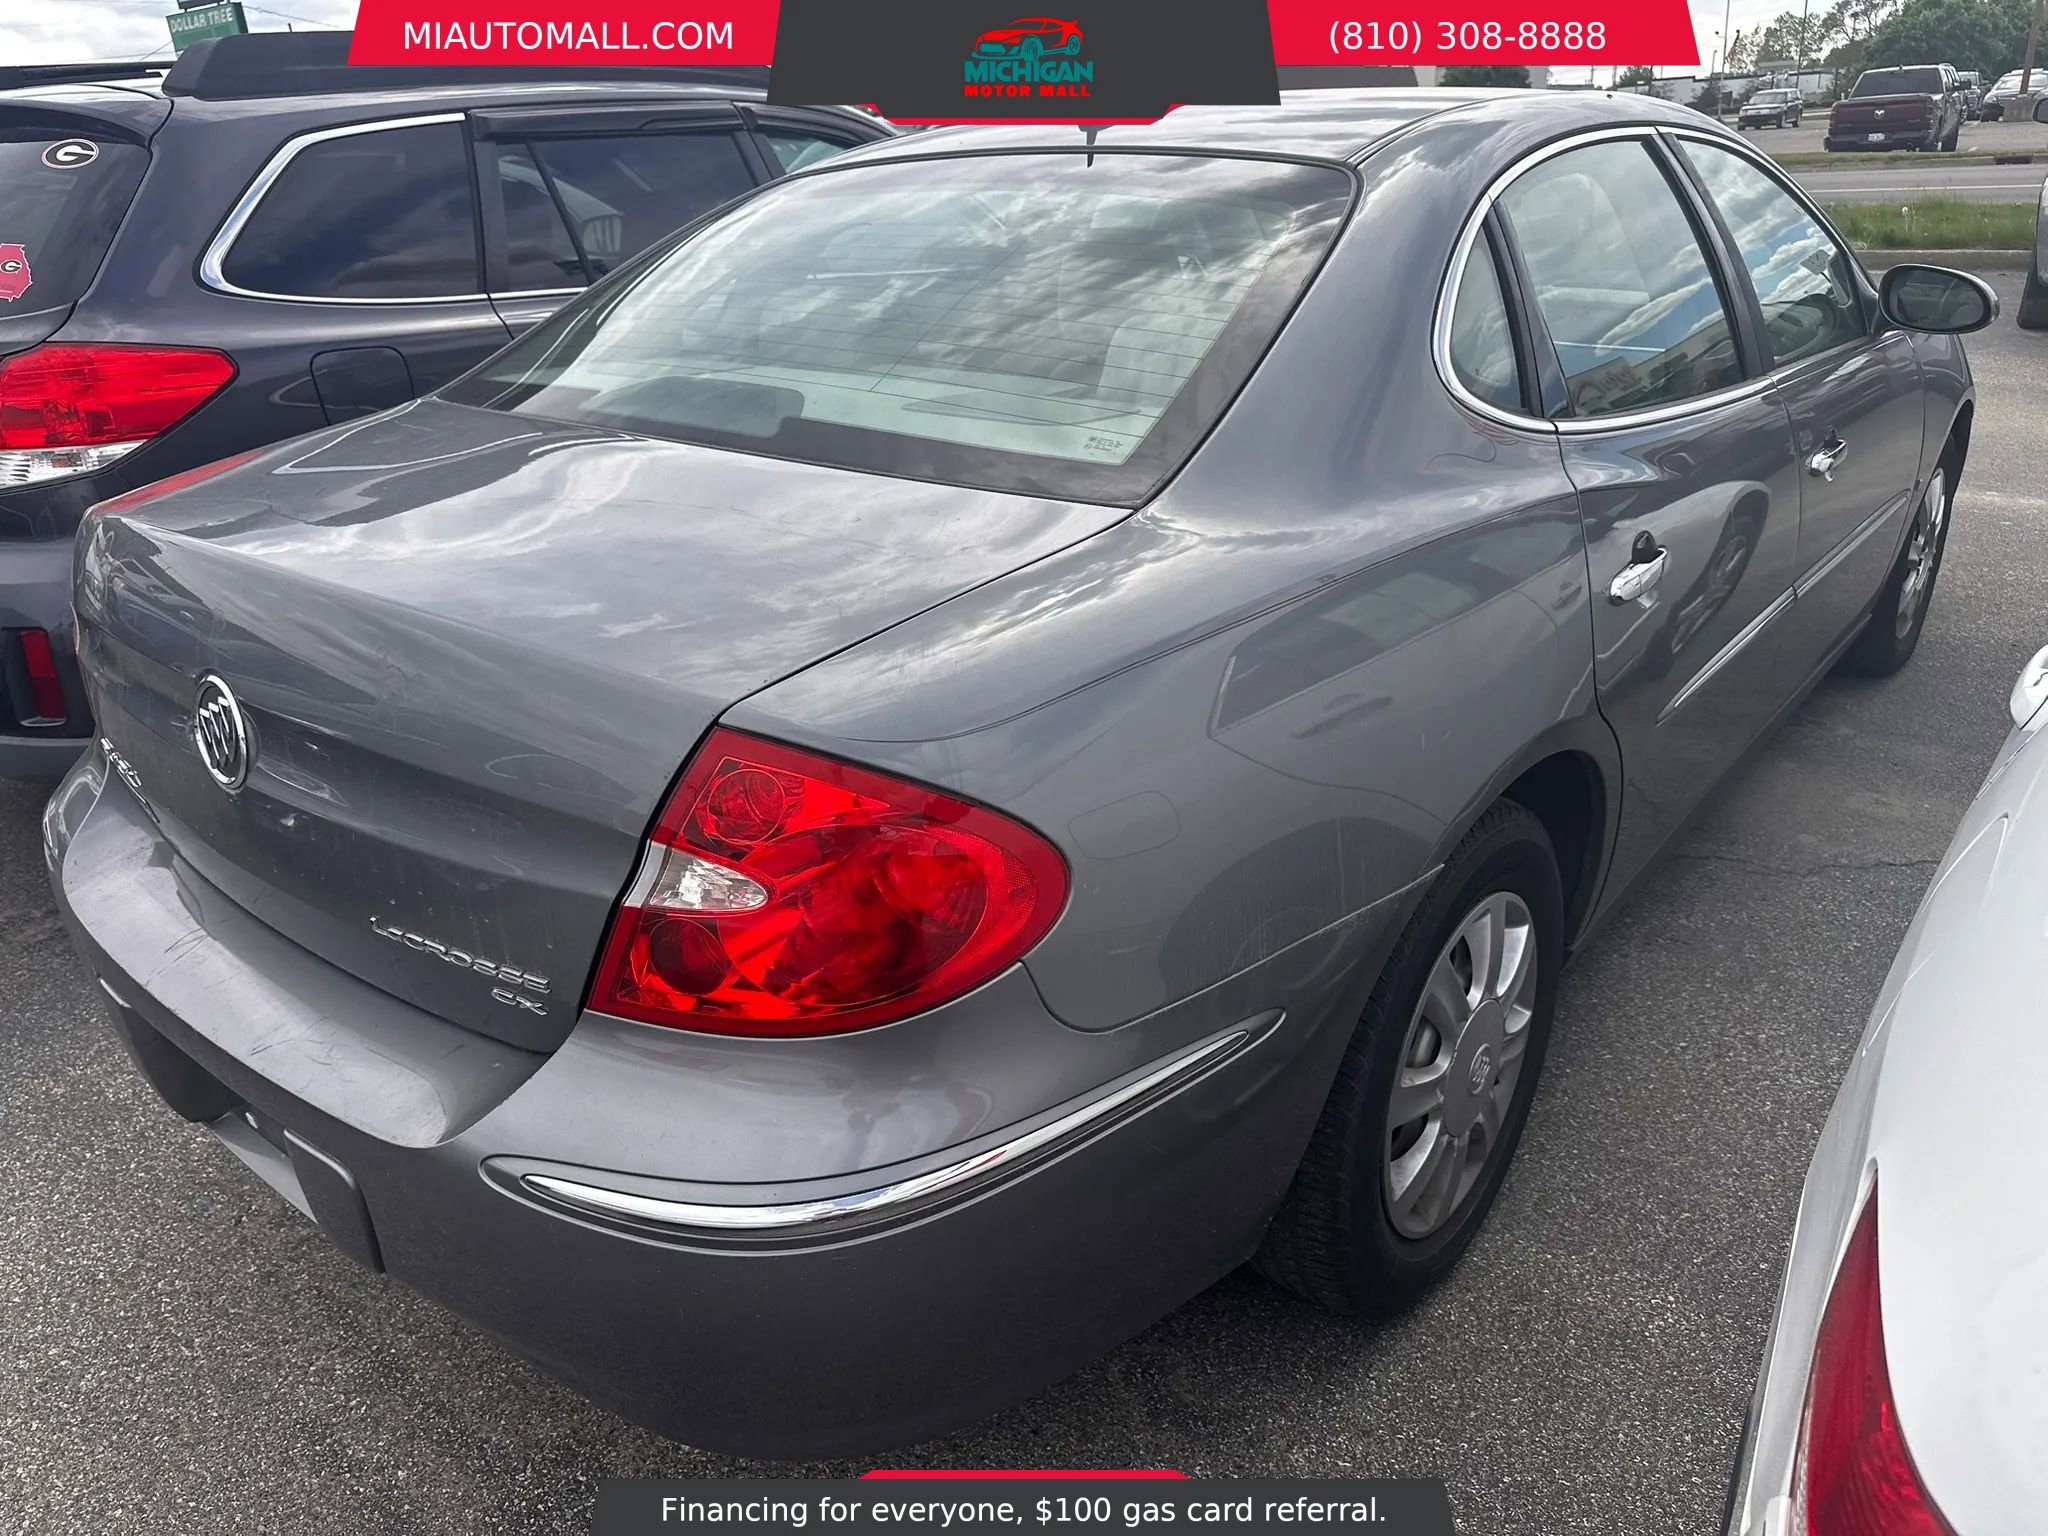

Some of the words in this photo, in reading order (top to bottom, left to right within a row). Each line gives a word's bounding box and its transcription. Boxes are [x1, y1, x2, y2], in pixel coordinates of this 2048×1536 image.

[170, 14, 206, 33] DOLLAR
[207, 7, 233, 25] TREE
[490, 987, 548, 1016] CX
